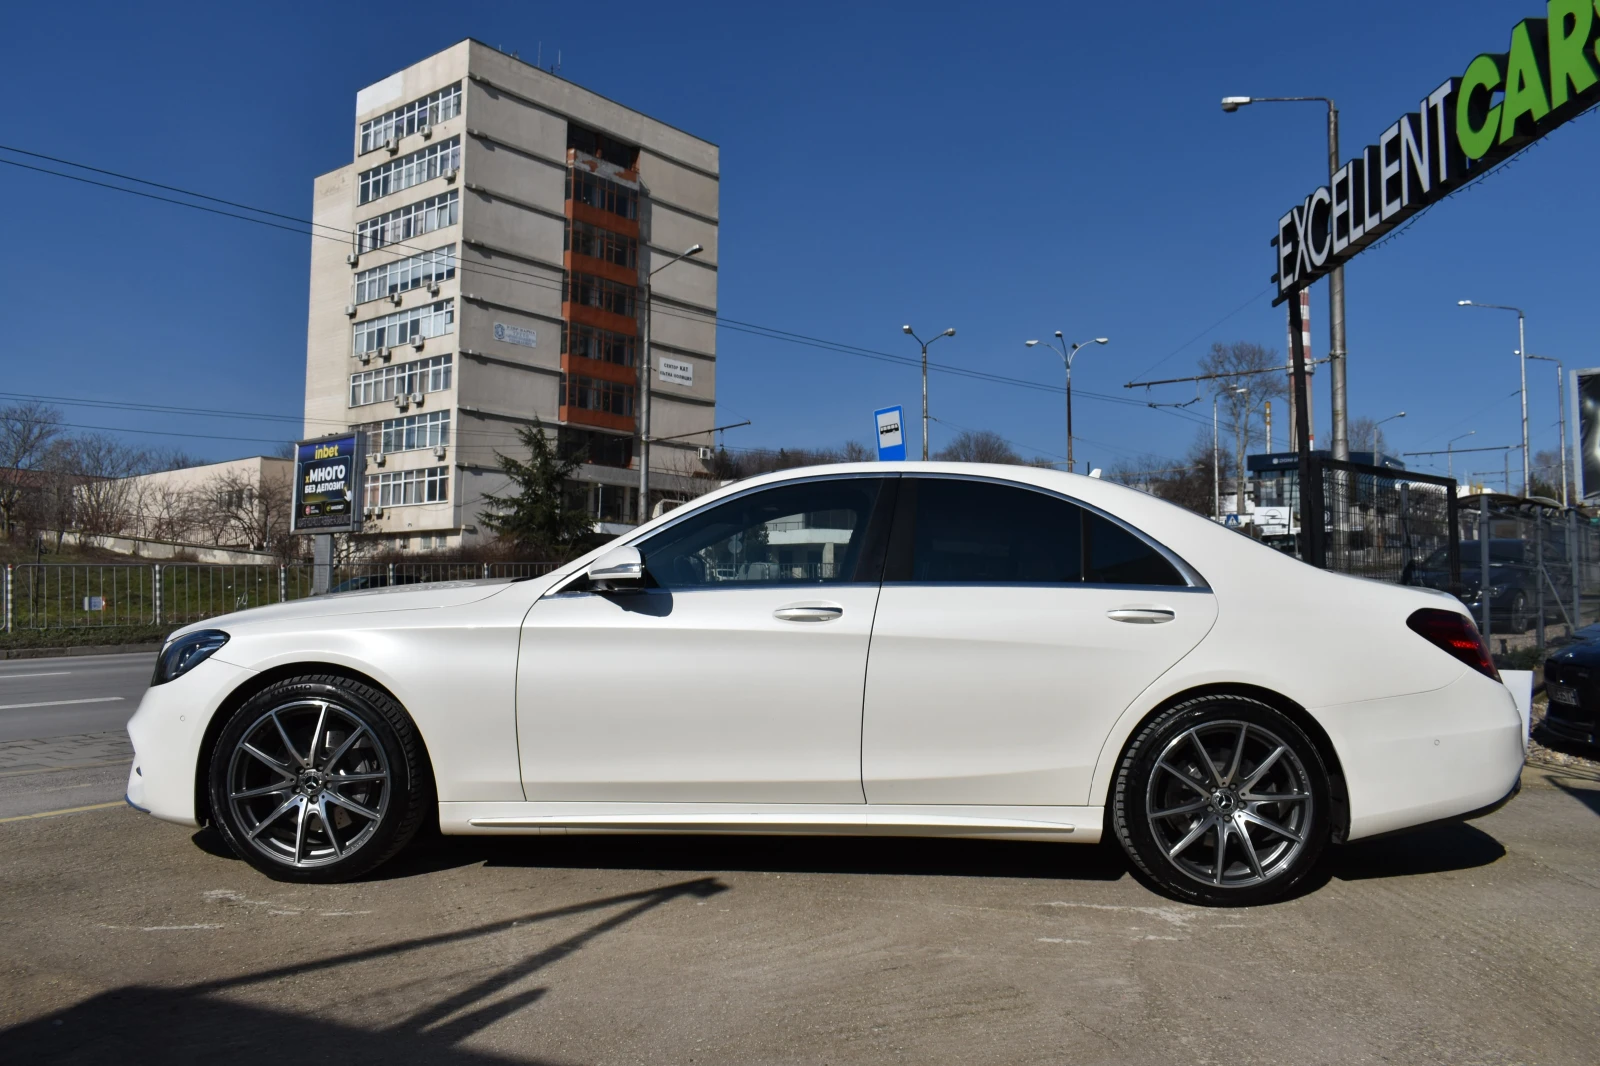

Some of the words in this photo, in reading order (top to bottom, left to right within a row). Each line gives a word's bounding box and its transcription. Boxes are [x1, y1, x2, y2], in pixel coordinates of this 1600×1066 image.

[1278, 78, 1452, 291] EXCELLENT
[1456, 0, 1600, 160] CAR
[315, 444, 339, 460] inbet
[304, 484, 316, 494] БЕЗ
[316, 480, 346, 494] ДЕПОЗИТ
